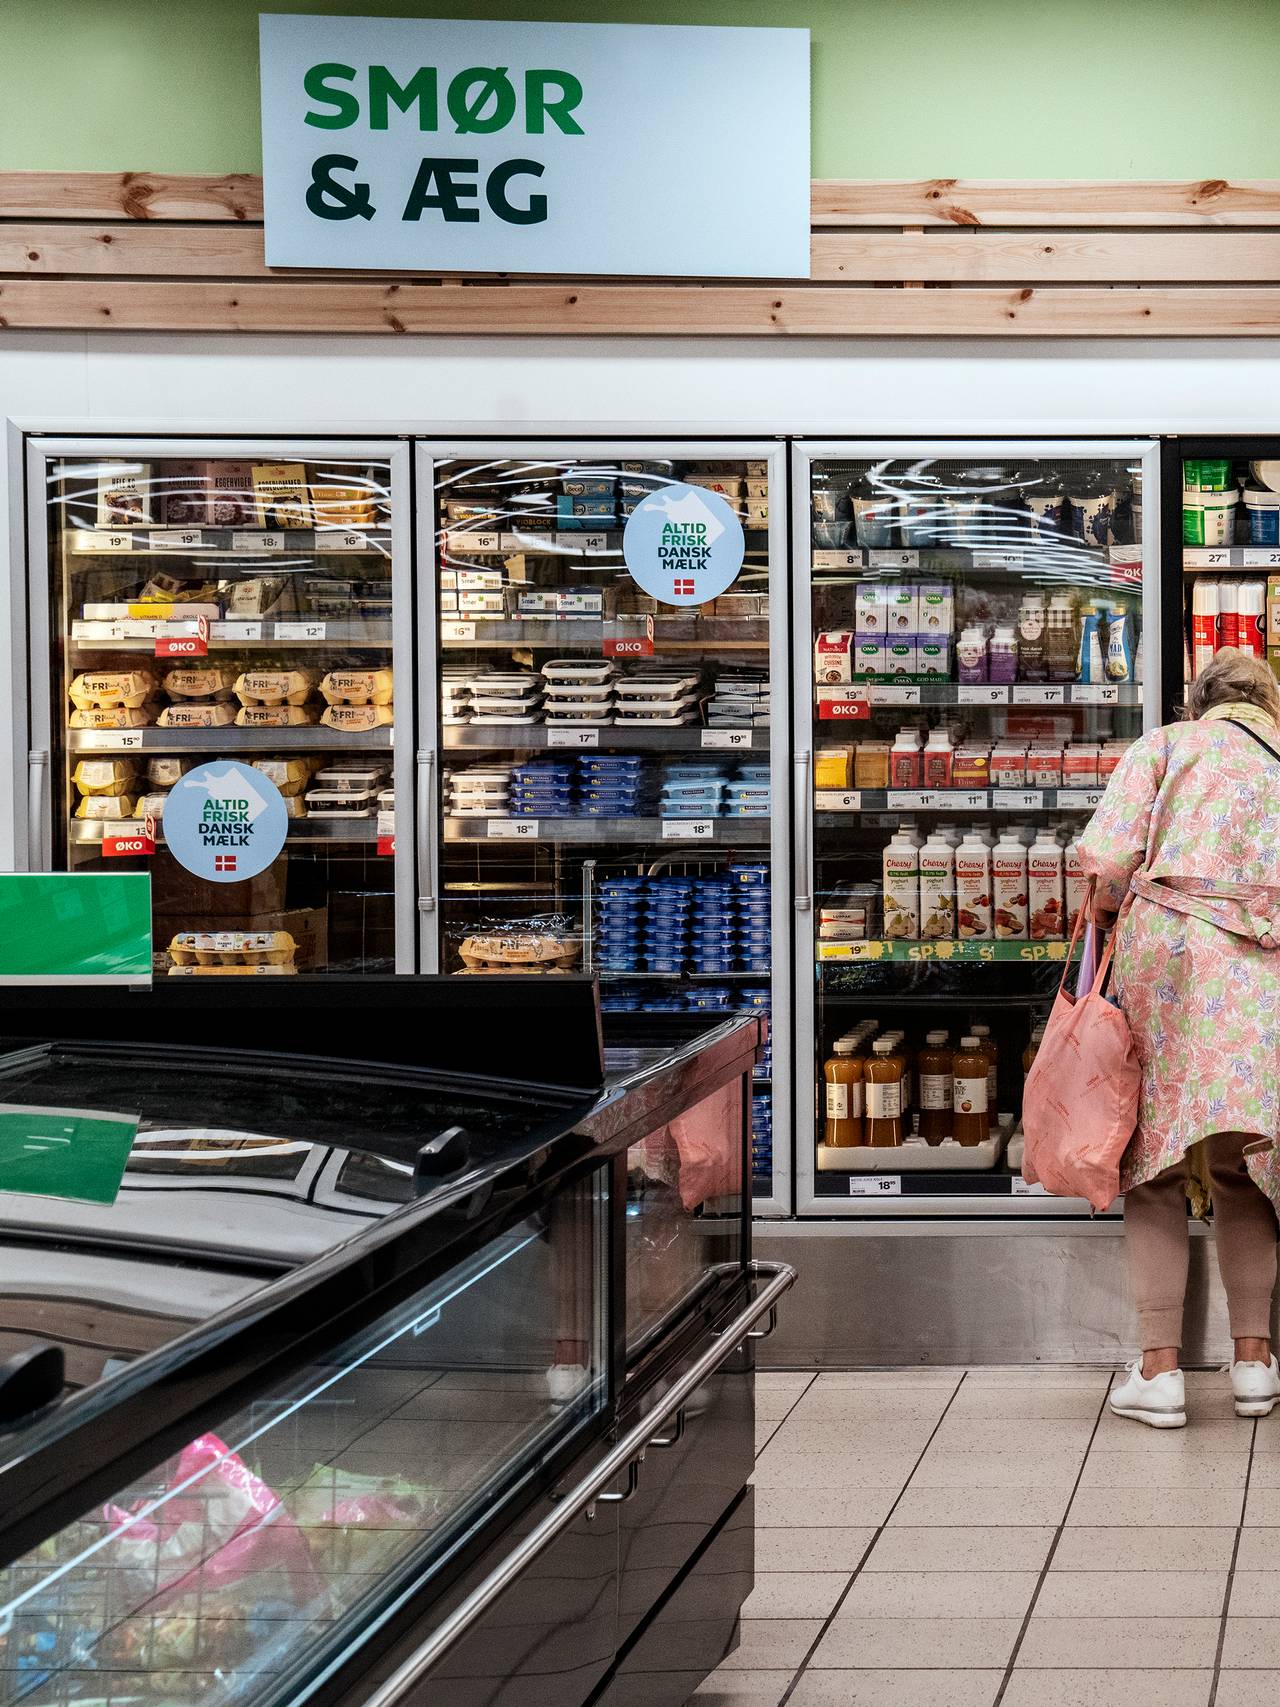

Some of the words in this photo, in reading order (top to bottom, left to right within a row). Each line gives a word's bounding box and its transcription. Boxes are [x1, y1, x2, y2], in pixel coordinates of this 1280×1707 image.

[303, 62, 585, 135] SMØR
[305, 154, 377, 220] &
[402, 157, 548, 224] ÆG
[662, 523, 707, 534] ALTID
[662, 535, 708, 546] FRISK
[657, 546, 712, 558] DANSK
[662, 558, 708, 570] MÆLK
[168, 641, 196, 652] ØKO
[615, 642, 642, 652] ØKO
[832, 704, 858, 714] ØKO
[203, 799, 249, 810] ALTID
[203, 811, 249, 822] FRISK
[198, 823, 254, 834] DANSK
[115, 840, 143, 851] ØKO
[203, 835, 250, 846] MÆLK
[886, 858, 913, 870] Cheasy
[922, 858, 948, 869] Cheasy
[958, 859, 985, 870] Cheasy
[996, 859, 1023, 870] Cheasy
[1031, 859, 1058, 869] Cheasy
